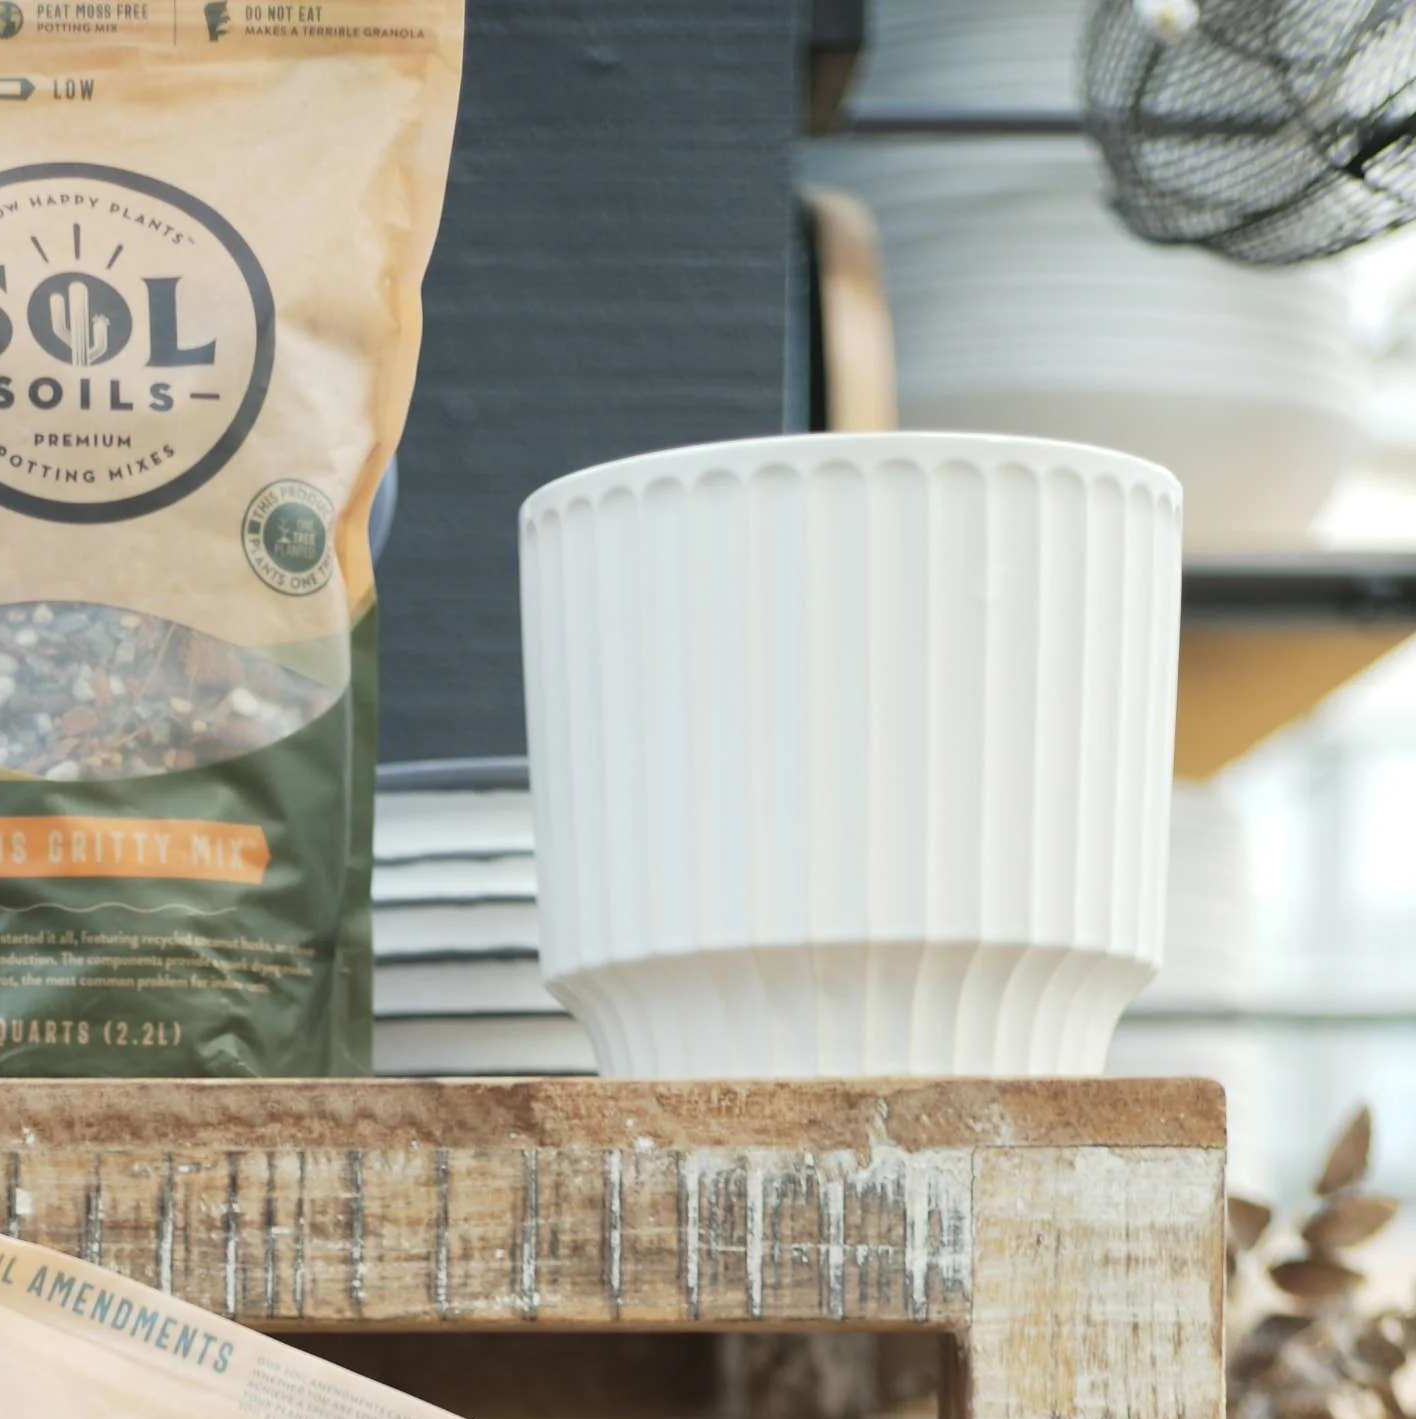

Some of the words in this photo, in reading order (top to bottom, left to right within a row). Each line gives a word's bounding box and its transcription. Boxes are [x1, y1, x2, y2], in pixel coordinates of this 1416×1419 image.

[37, 4, 70, 19] PEAT
[76, 4, 111, 19] MOSS
[117, 4, 148, 20] FREE
[245, 6, 262, 20] DO
[268, 6, 294, 20] NOT
[299, 7, 322, 21] EAT
[37, 23, 91, 33] POTTING
[95, 24, 118, 33] MIX
[244, 26, 287, 36] MAKES
[291, 27, 298, 37] A
[302, 27, 360, 38] TERRIBLE
[363, 28, 425, 39] GRANOLA
[53, 79, 94, 100] LOW
[30, 195, 99, 209] HAPPY
[34, 433, 133, 448] PREMIUM
[109, 444, 176, 482] MIXES
[48, 830, 170, 865] GRITTY
[1, 931, 43, 944] started
[104, 1021, 181, 1048] (2.2L)
[27, 1264, 235, 1375] AMENDMENTS
